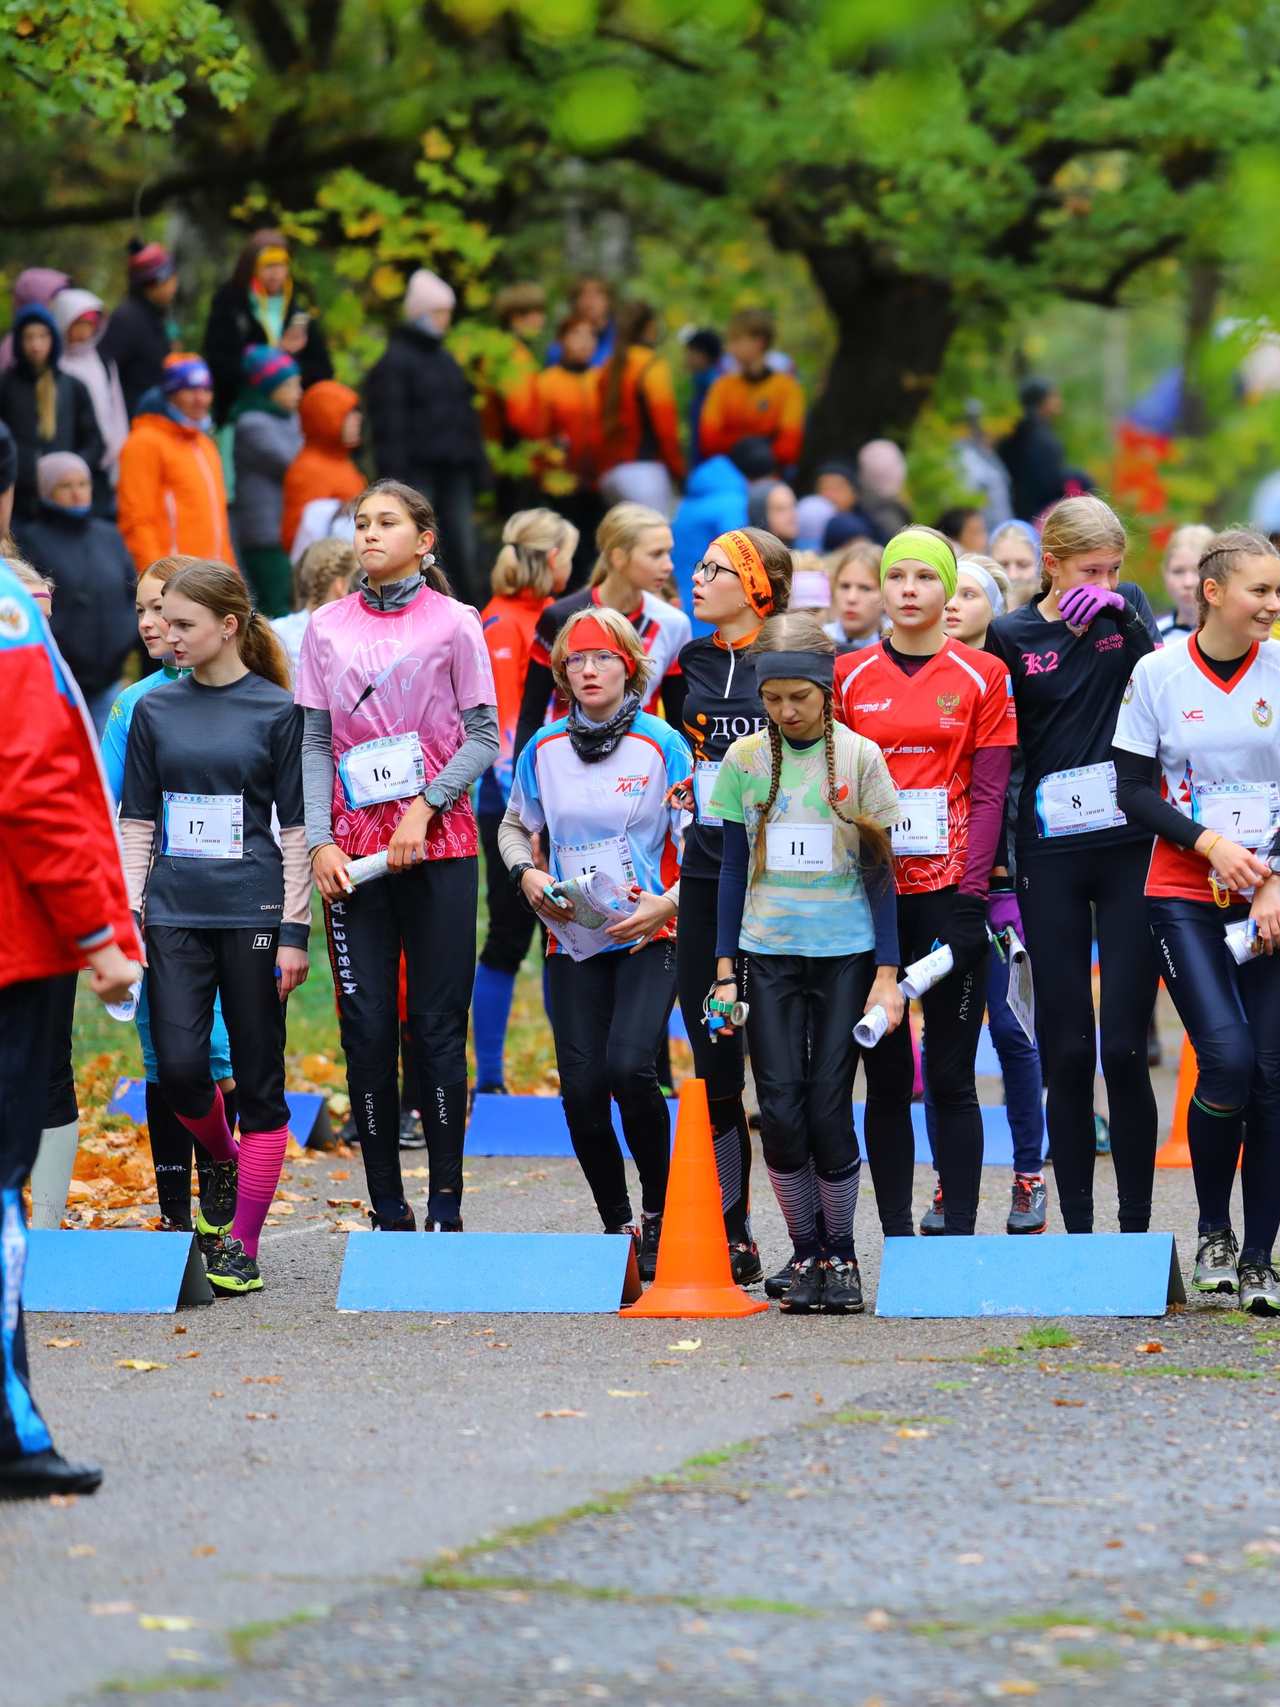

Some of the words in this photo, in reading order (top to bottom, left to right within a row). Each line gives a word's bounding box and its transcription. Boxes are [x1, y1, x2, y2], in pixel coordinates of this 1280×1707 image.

[883, 746, 936, 754] RUSSIA
[372, 764, 391, 782] 16
[1071, 794, 1082, 810] 8
[1232, 811, 1241, 826] 7
[188, 820, 205, 835] 17
[790, 841, 804, 855] 11
[331, 901, 358, 995] НАВСЕГД
[1160, 937, 1178, 979] ARSWEAR
[365, 1093, 377, 1135] ARSWEAR
[436, 1086, 448, 1125] ARSWEA
